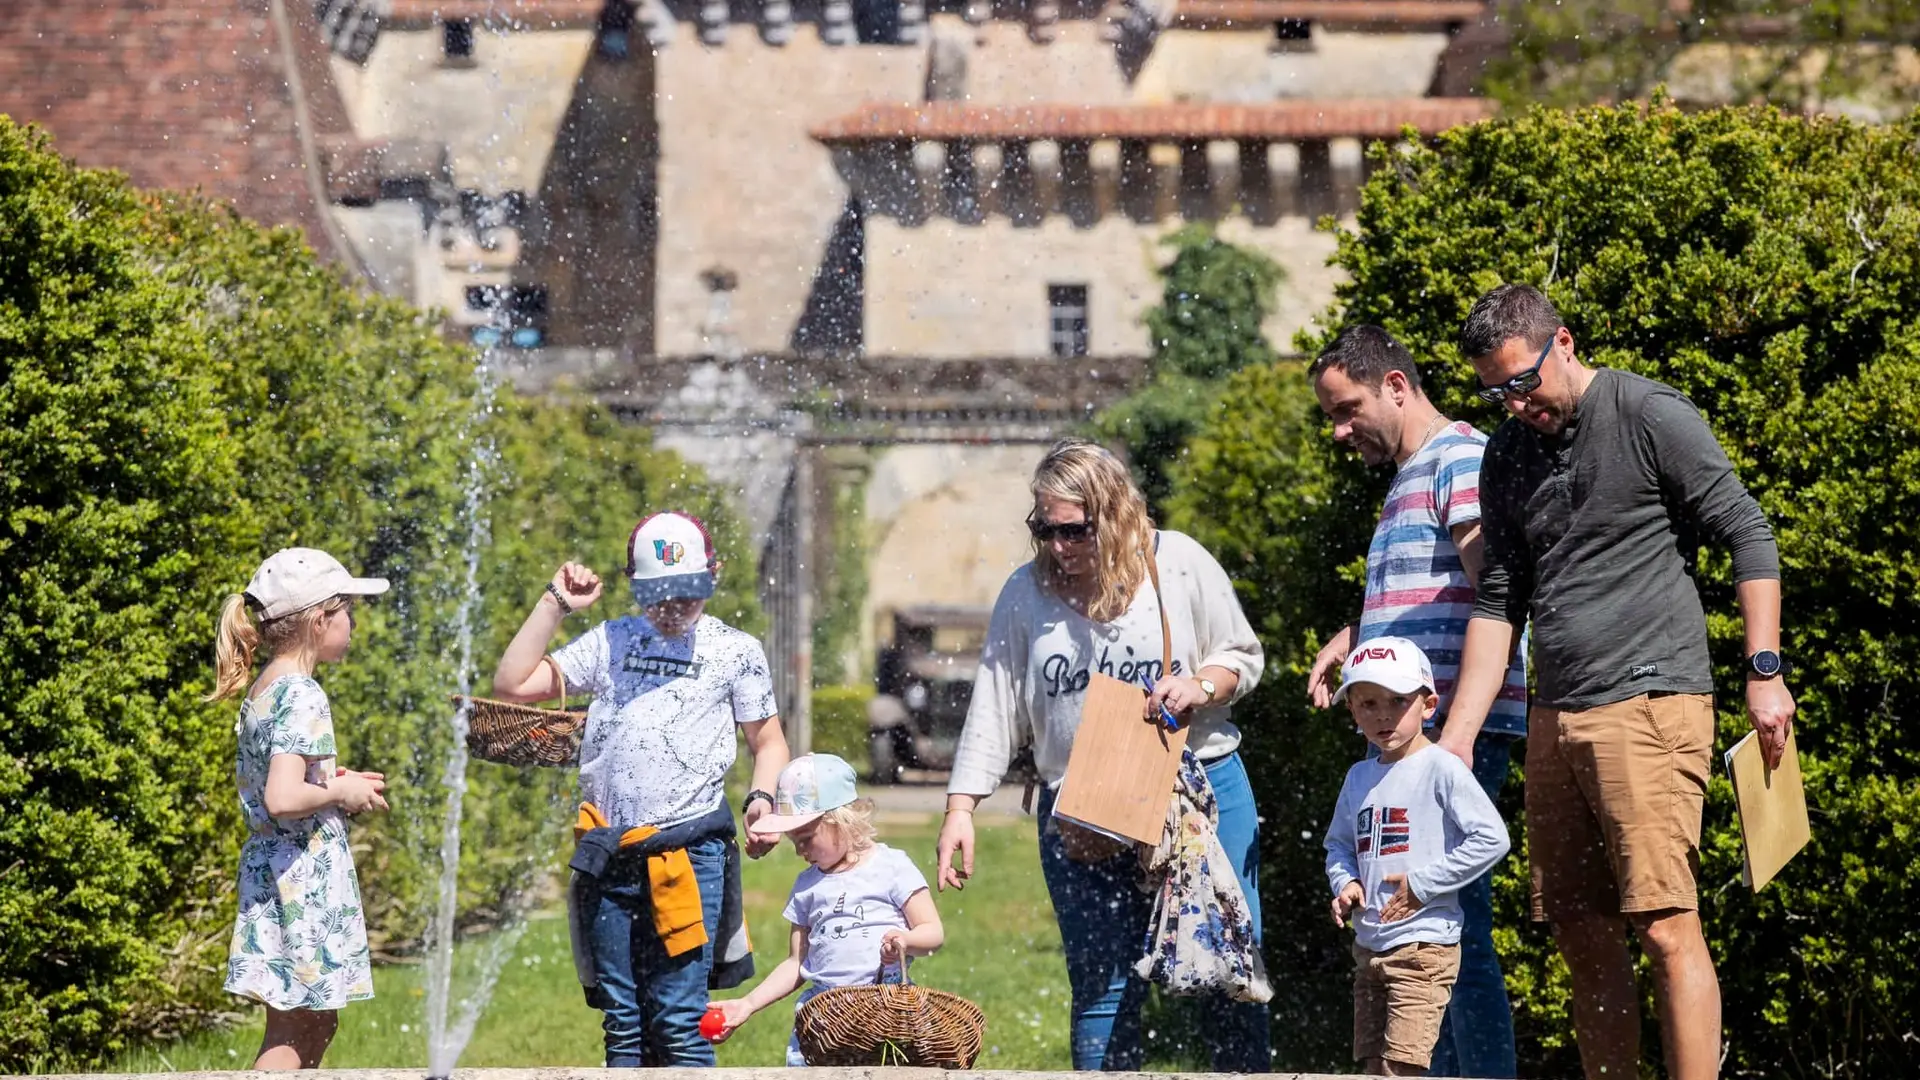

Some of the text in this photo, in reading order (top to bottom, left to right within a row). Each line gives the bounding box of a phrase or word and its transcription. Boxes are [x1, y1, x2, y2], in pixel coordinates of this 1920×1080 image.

[653, 540, 685, 566] YEP
[1043, 645, 1182, 697] Bohème
[1351, 648, 1397, 668] NASA
